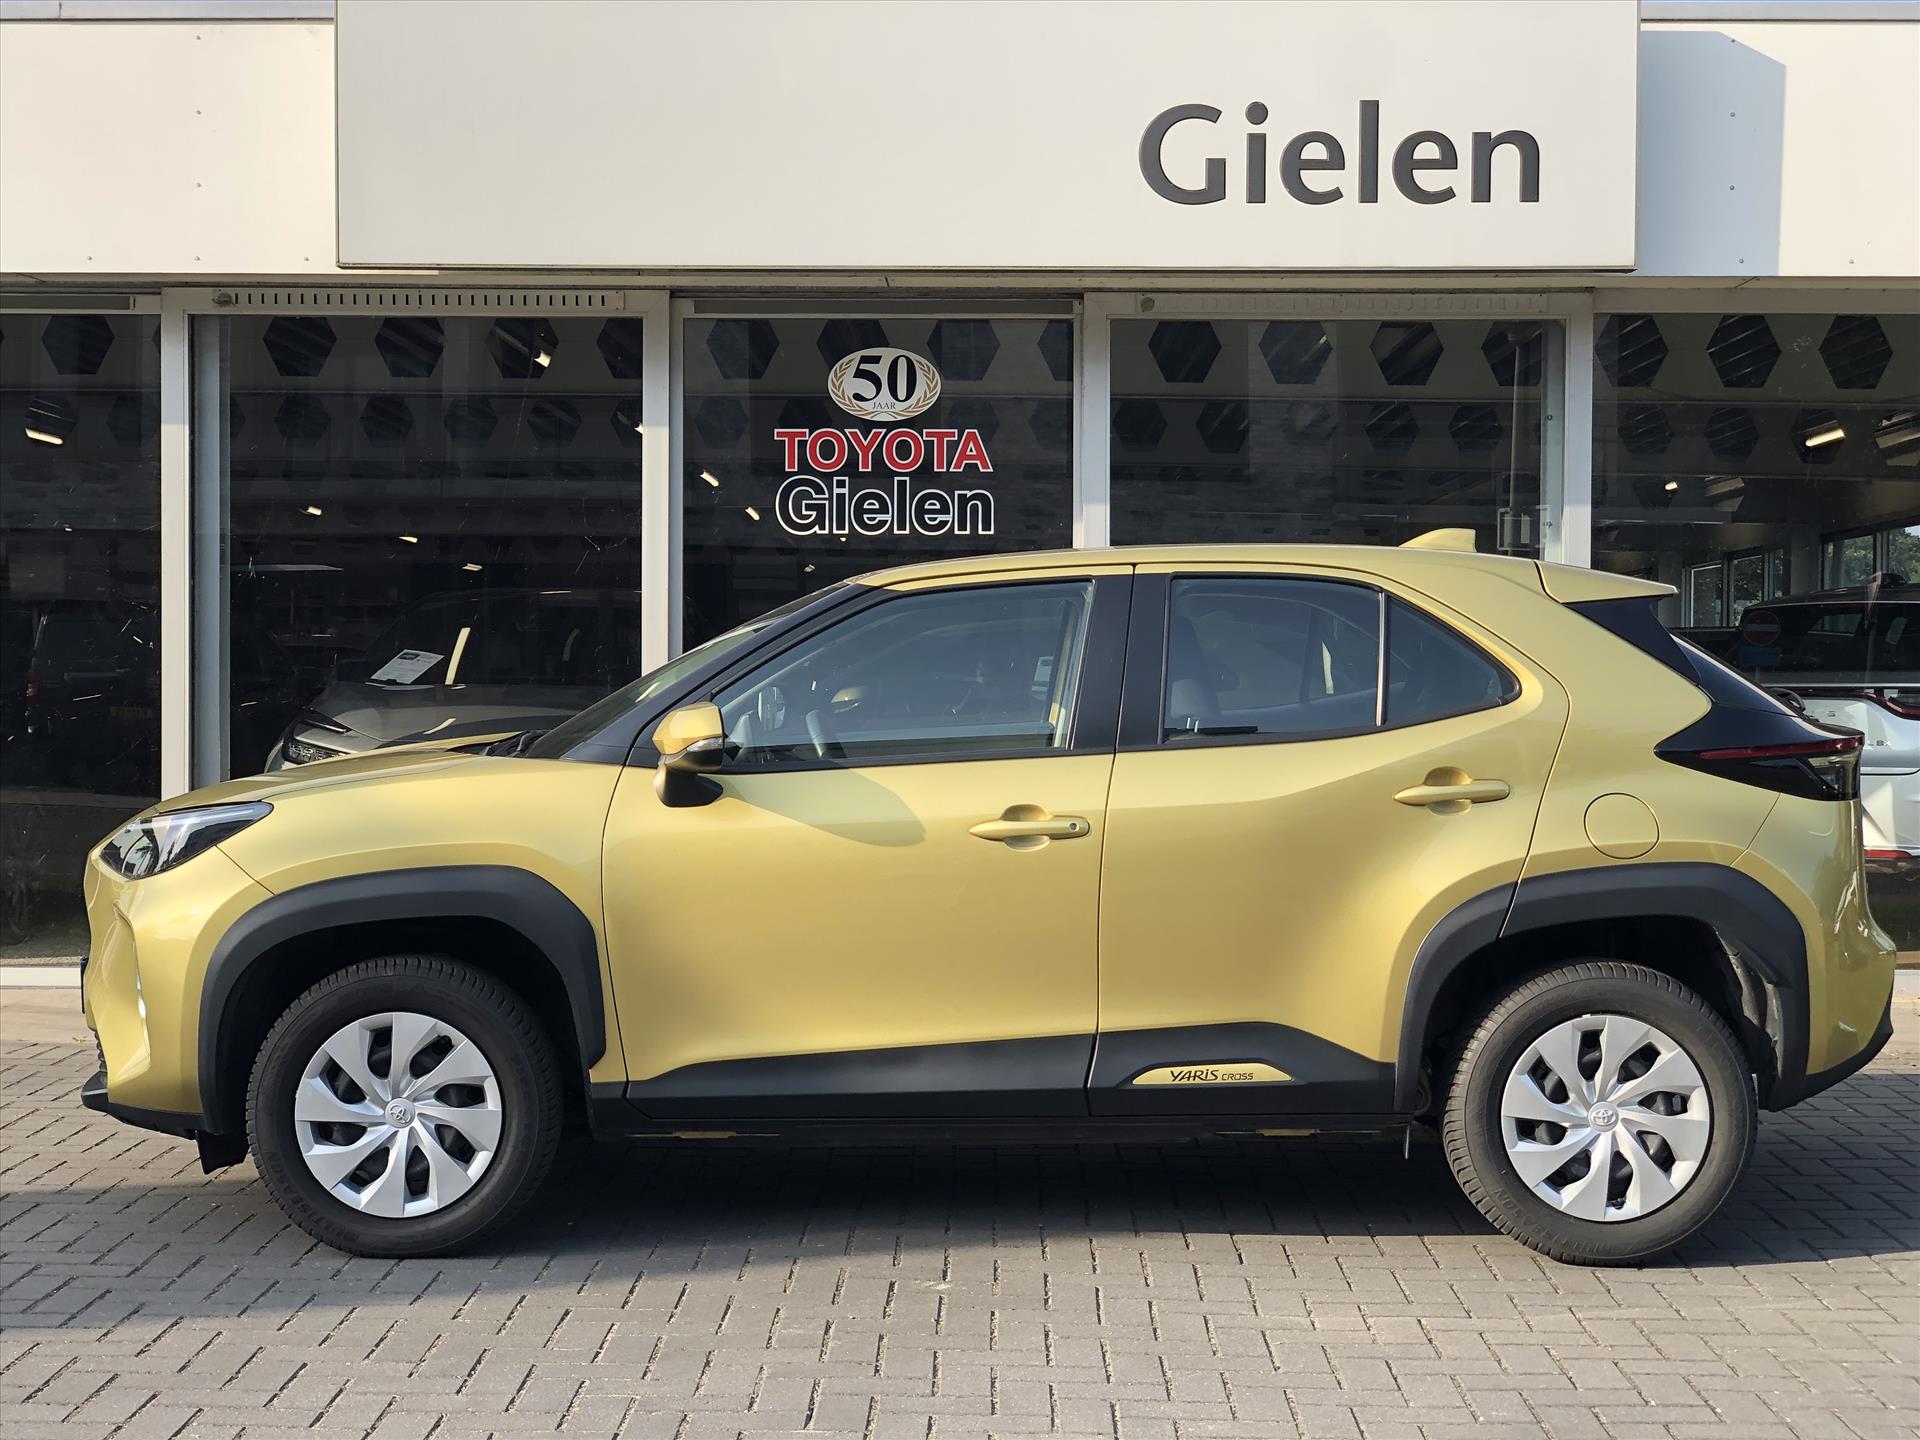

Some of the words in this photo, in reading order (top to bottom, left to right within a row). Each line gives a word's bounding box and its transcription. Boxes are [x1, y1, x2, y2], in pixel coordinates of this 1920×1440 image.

[1139, 99, 1540, 205] Gielen
[852, 354, 917, 402] 50
[872, 402, 897, 410] JAAR
[774, 428, 993, 472] TOYOTA
[775, 475, 994, 535] Gielen
[1170, 1069, 1219, 1082] YARIS
[1221, 1072, 1254, 1081] CROSS
